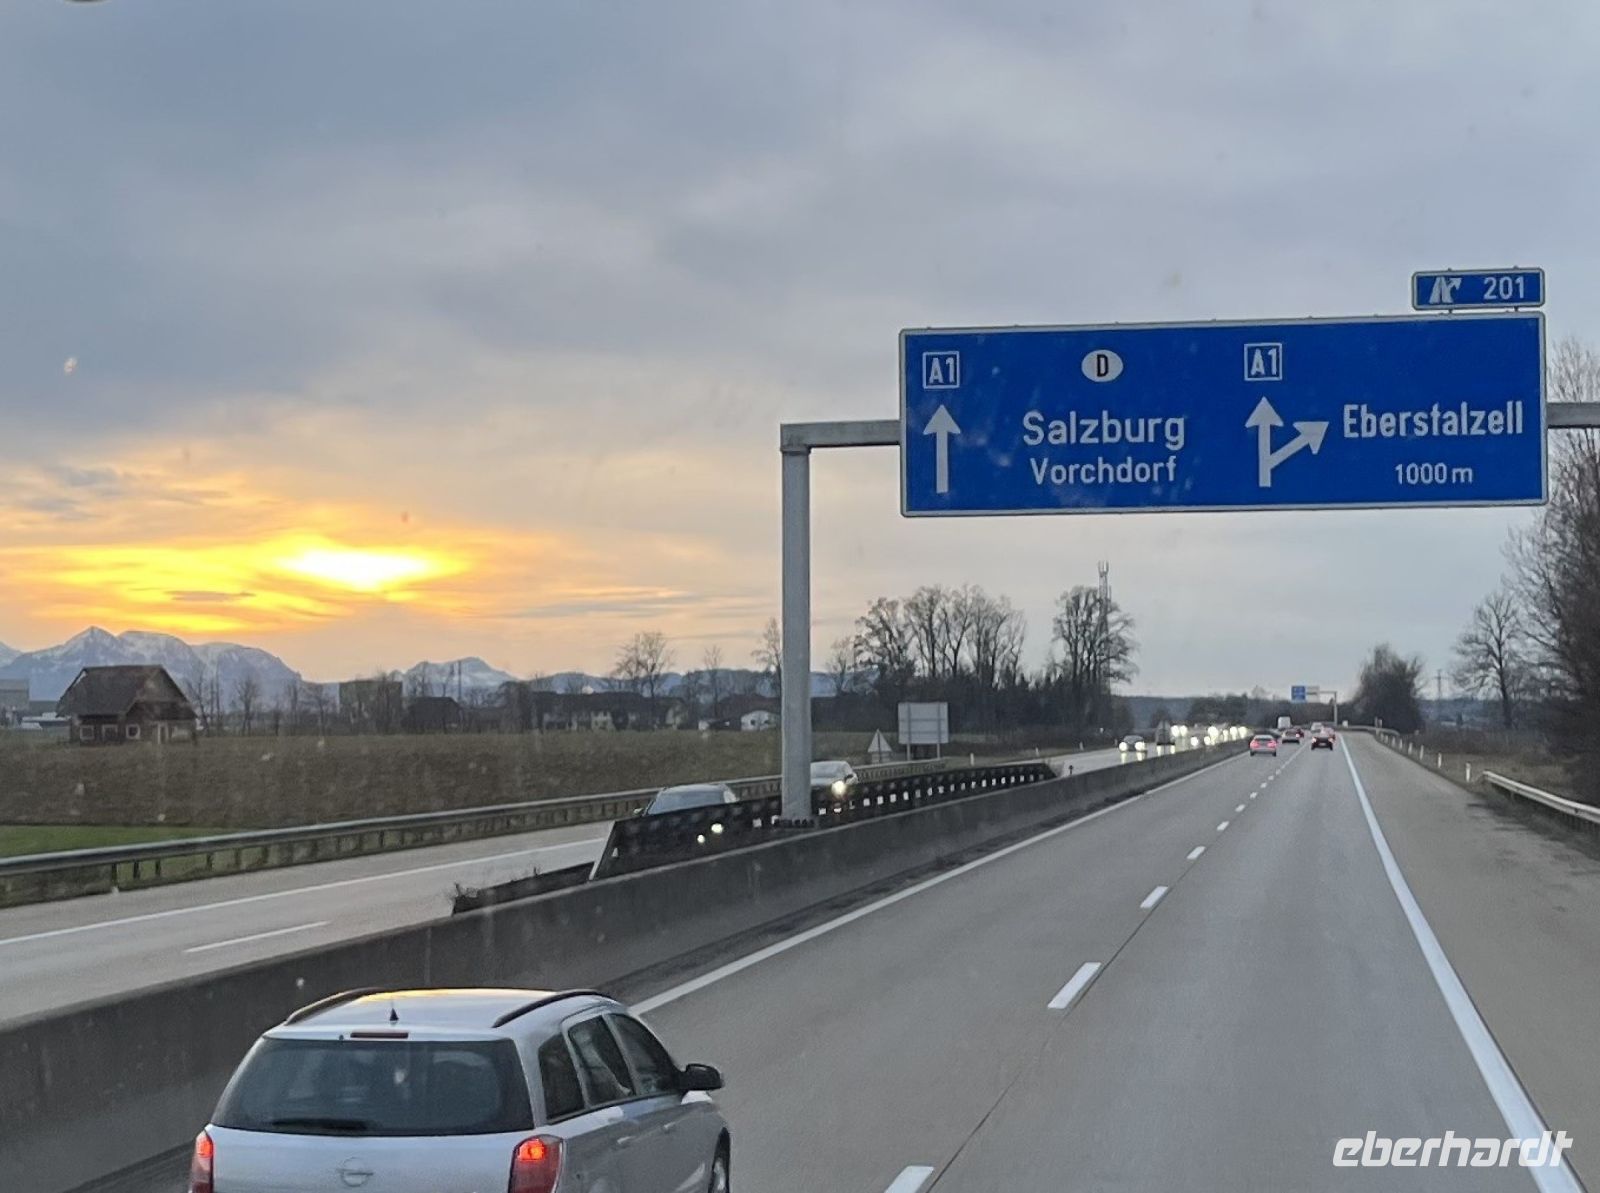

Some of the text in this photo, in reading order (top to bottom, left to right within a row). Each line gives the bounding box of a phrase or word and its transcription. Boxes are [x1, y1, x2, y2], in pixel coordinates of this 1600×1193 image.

[1483, 276, 1526, 300] 201
[928, 358, 955, 383] A1
[1096, 354, 1109, 378] D
[1250, 348, 1277, 376] A1
[1022, 410, 1186, 451] Salzburg
[1342, 401, 1523, 439] Eberstalzell
[1030, 456, 1177, 485] Vorchdorf
